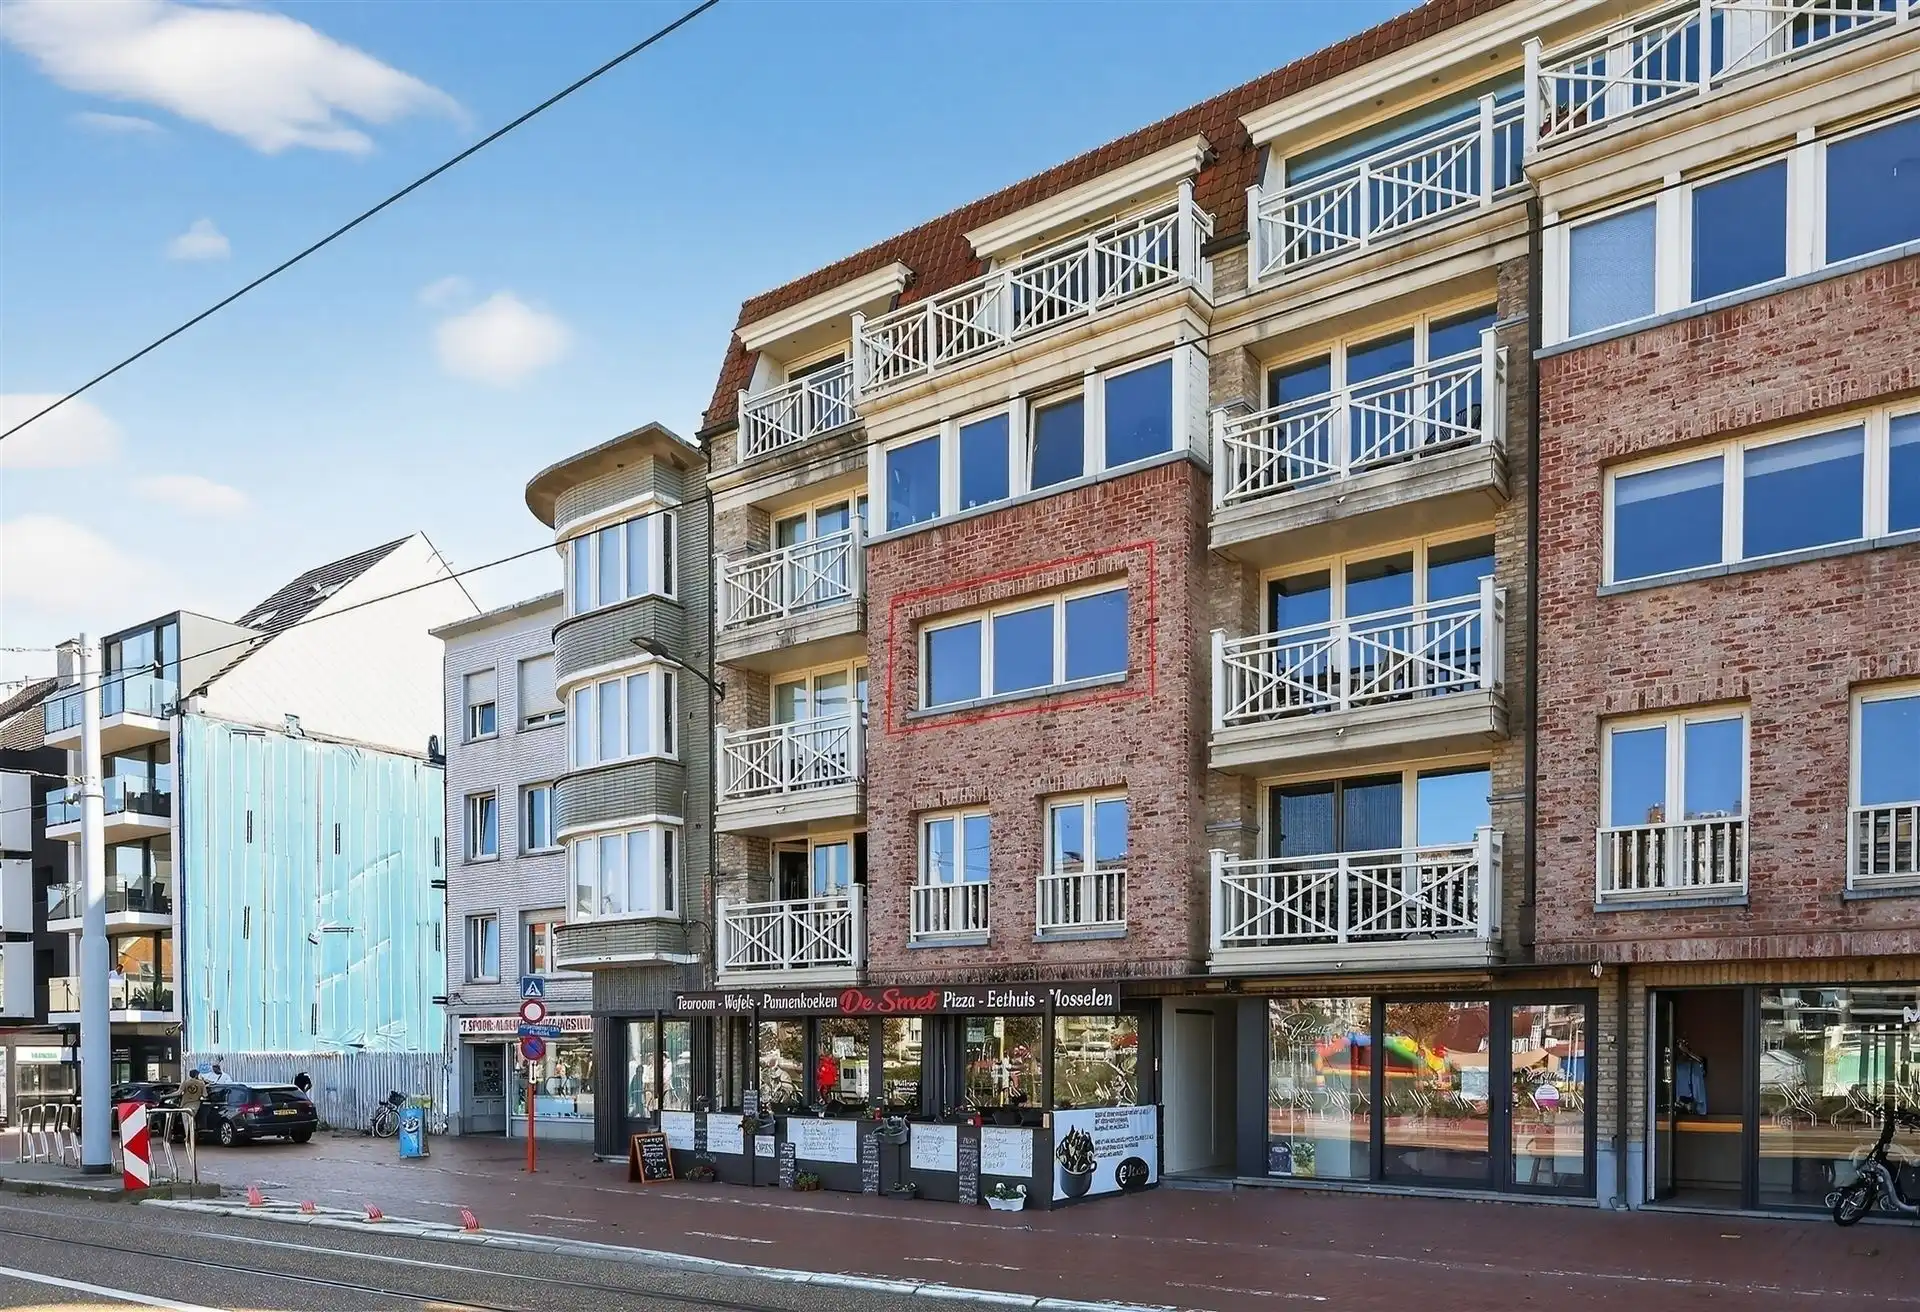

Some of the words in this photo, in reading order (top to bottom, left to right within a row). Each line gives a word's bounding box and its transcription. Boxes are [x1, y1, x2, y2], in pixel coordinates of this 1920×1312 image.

[677, 995, 716, 1010] Tearoom
[724, 994, 755, 1012] Wafels
[763, 992, 838, 1009] Pannenkoeken
[840, 989, 875, 1013] De
[877, 988, 940, 1013] Smet
[943, 991, 976, 1008] Pizza
[987, 989, 1036, 1008] Eethuis
